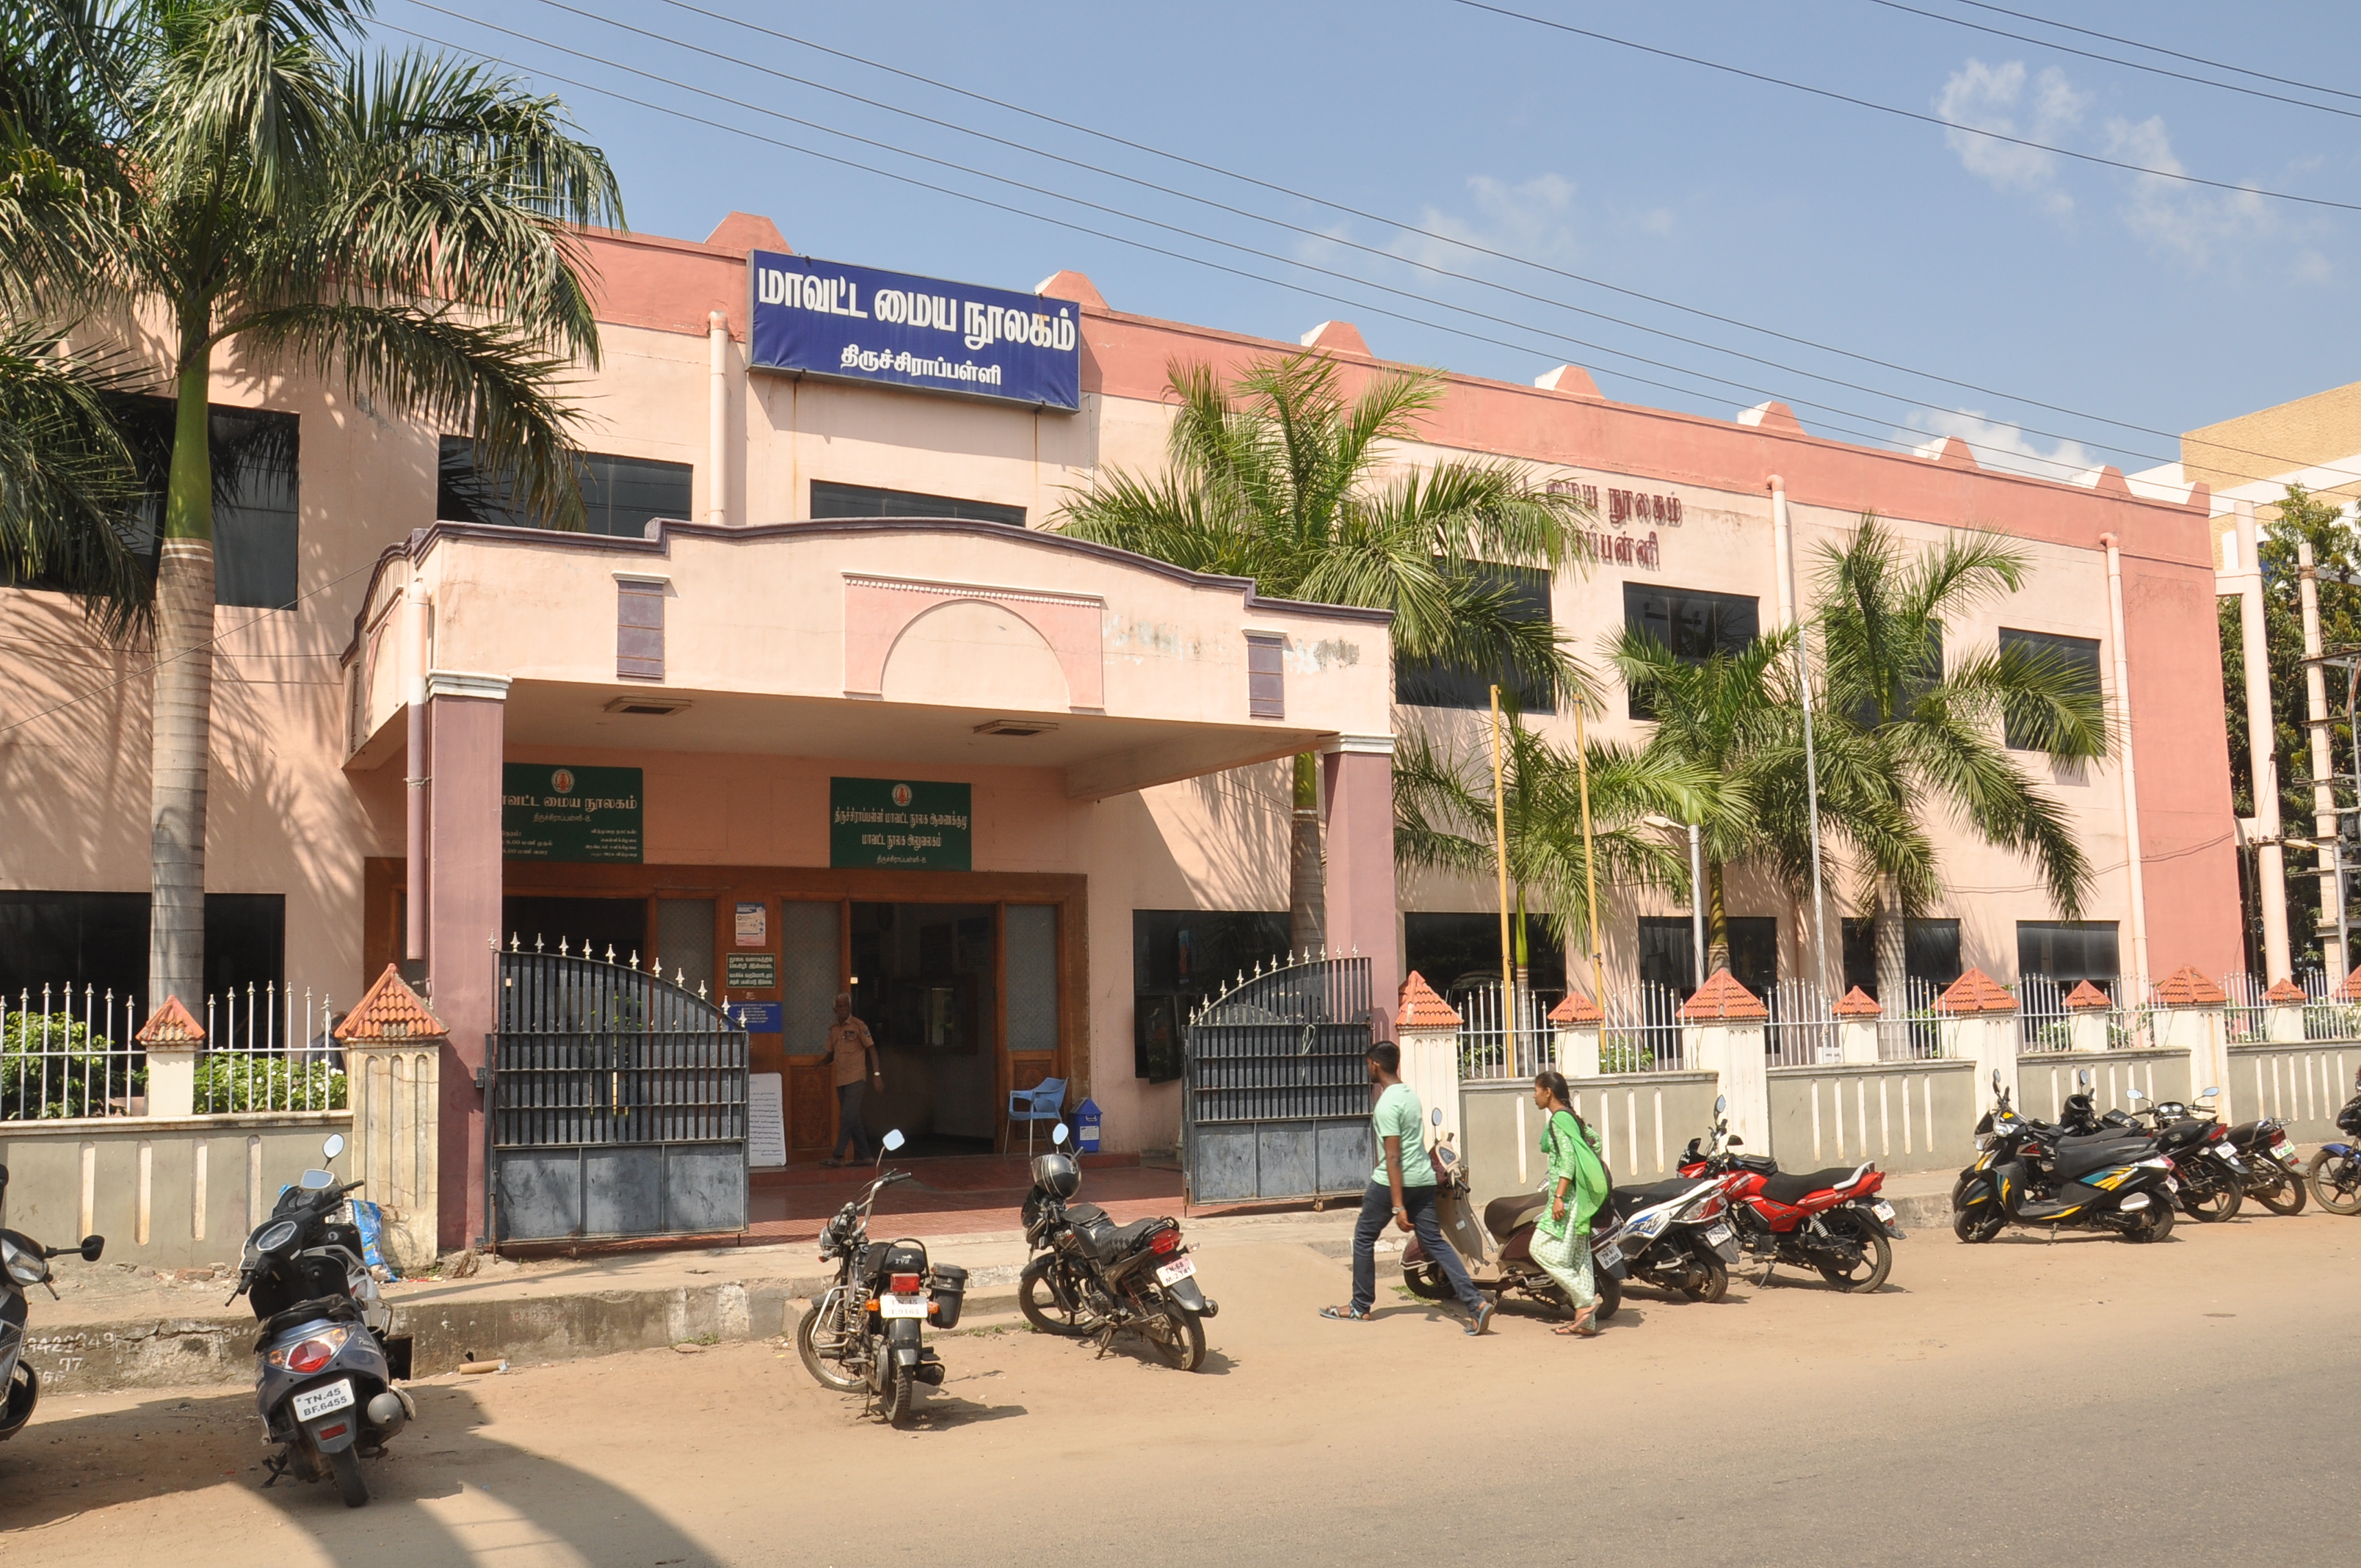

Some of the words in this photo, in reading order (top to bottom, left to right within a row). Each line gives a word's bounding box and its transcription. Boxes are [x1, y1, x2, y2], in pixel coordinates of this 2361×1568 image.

[758, 267, 868, 319] மாவட்ட
[874, 288, 957, 332] மைய
[964, 302, 1076, 352] நூலகம்
[840, 344, 1001, 386] திருச்சிராப்பள்ளி
[1608, 487, 1683, 524] நூலகம்
[501, 795, 540, 807] ாவட்ட
[544, 796, 581, 808] மைய
[584, 795, 637, 813] நூலகம்
[885, 811, 908, 824] மாவட்ட
[861, 833, 885, 845] மாவட்ட
[887, 834, 906, 850] நூலக
[303, 1395, 347, 1416] BF.6455
[304, 1387, 341, 1405] TN.45
